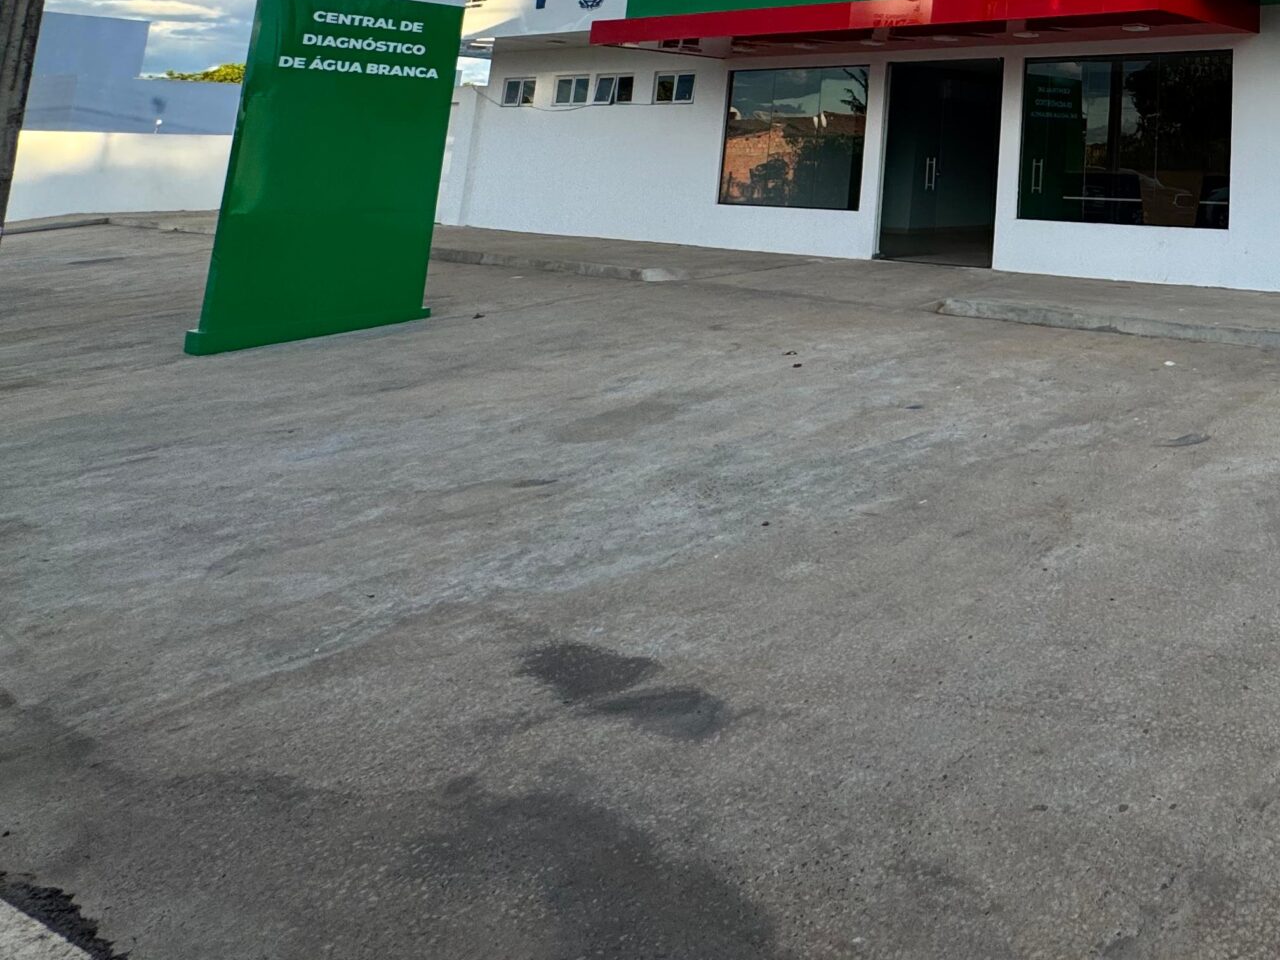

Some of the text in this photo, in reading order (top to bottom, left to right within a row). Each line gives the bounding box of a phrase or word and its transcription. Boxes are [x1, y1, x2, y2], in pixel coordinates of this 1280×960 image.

[313, 10, 424, 33] CENTRAL DE
[302, 33, 426, 55] DIAGNÓSTICO
[278, 55, 439, 79] DE ÁGUA BRANCA
